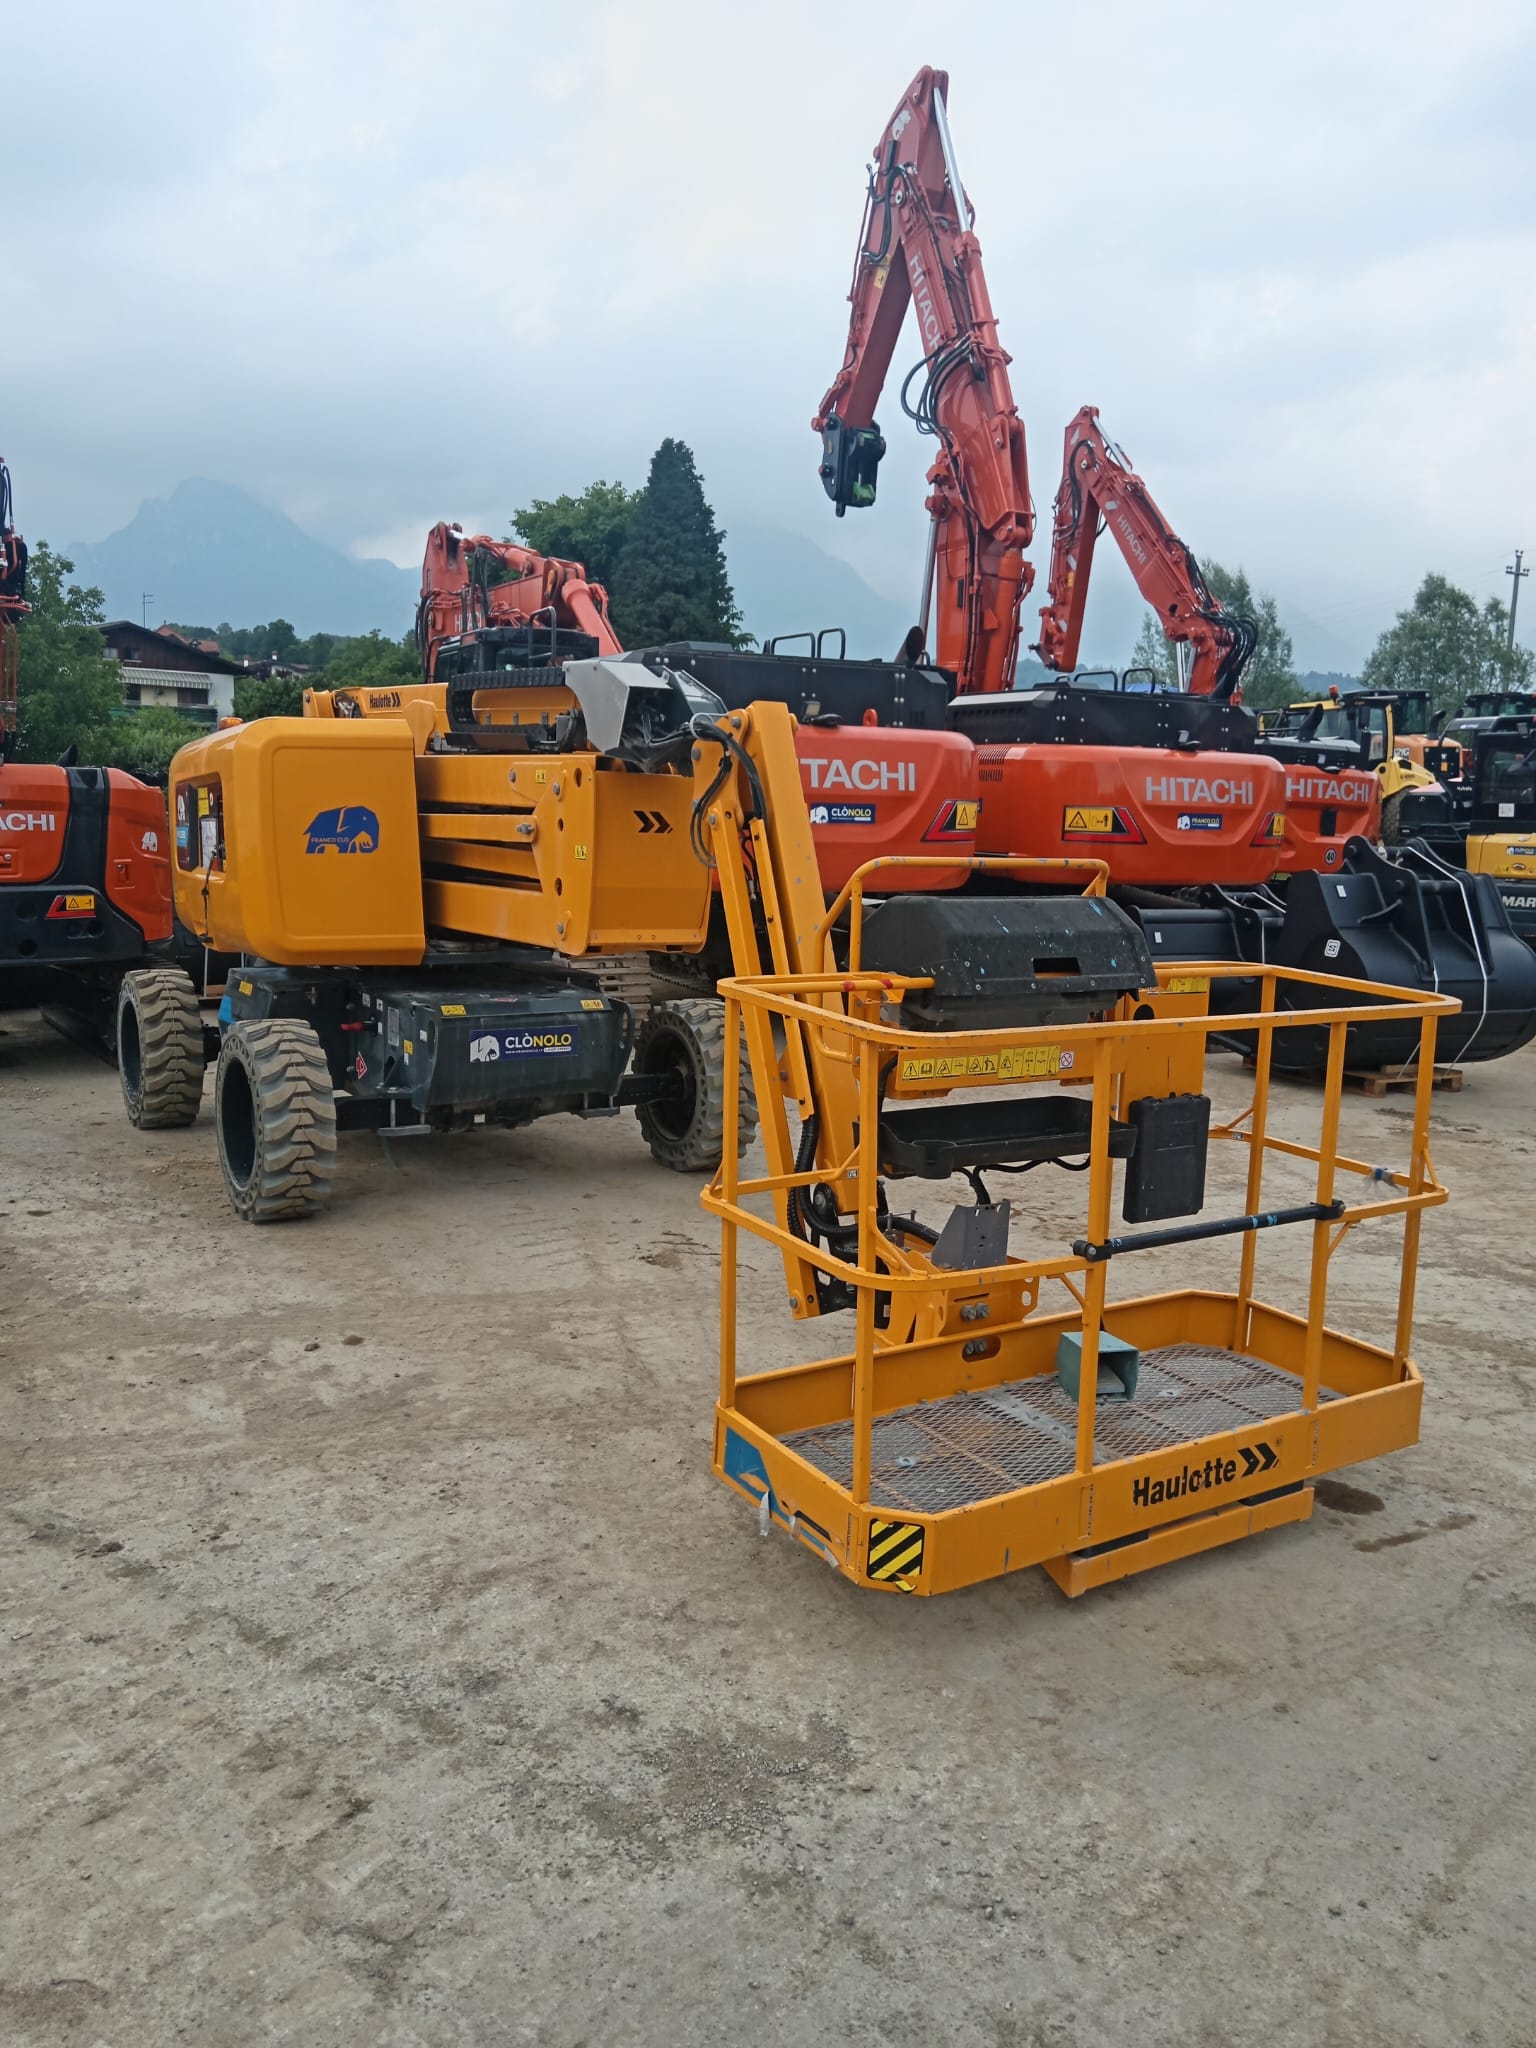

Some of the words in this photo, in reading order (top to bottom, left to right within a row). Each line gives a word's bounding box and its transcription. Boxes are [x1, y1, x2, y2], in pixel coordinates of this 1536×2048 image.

[1117, 514, 1147, 564] HITACHI
[1146, 776, 1254, 805] HITACHI
[1286, 778, 1369, 803] HITACHI
[1325, 849, 1336, 864] 40
[505, 1032, 572, 1049] CLÒNOLO
[1133, 1457, 1237, 1507] Haulotte
